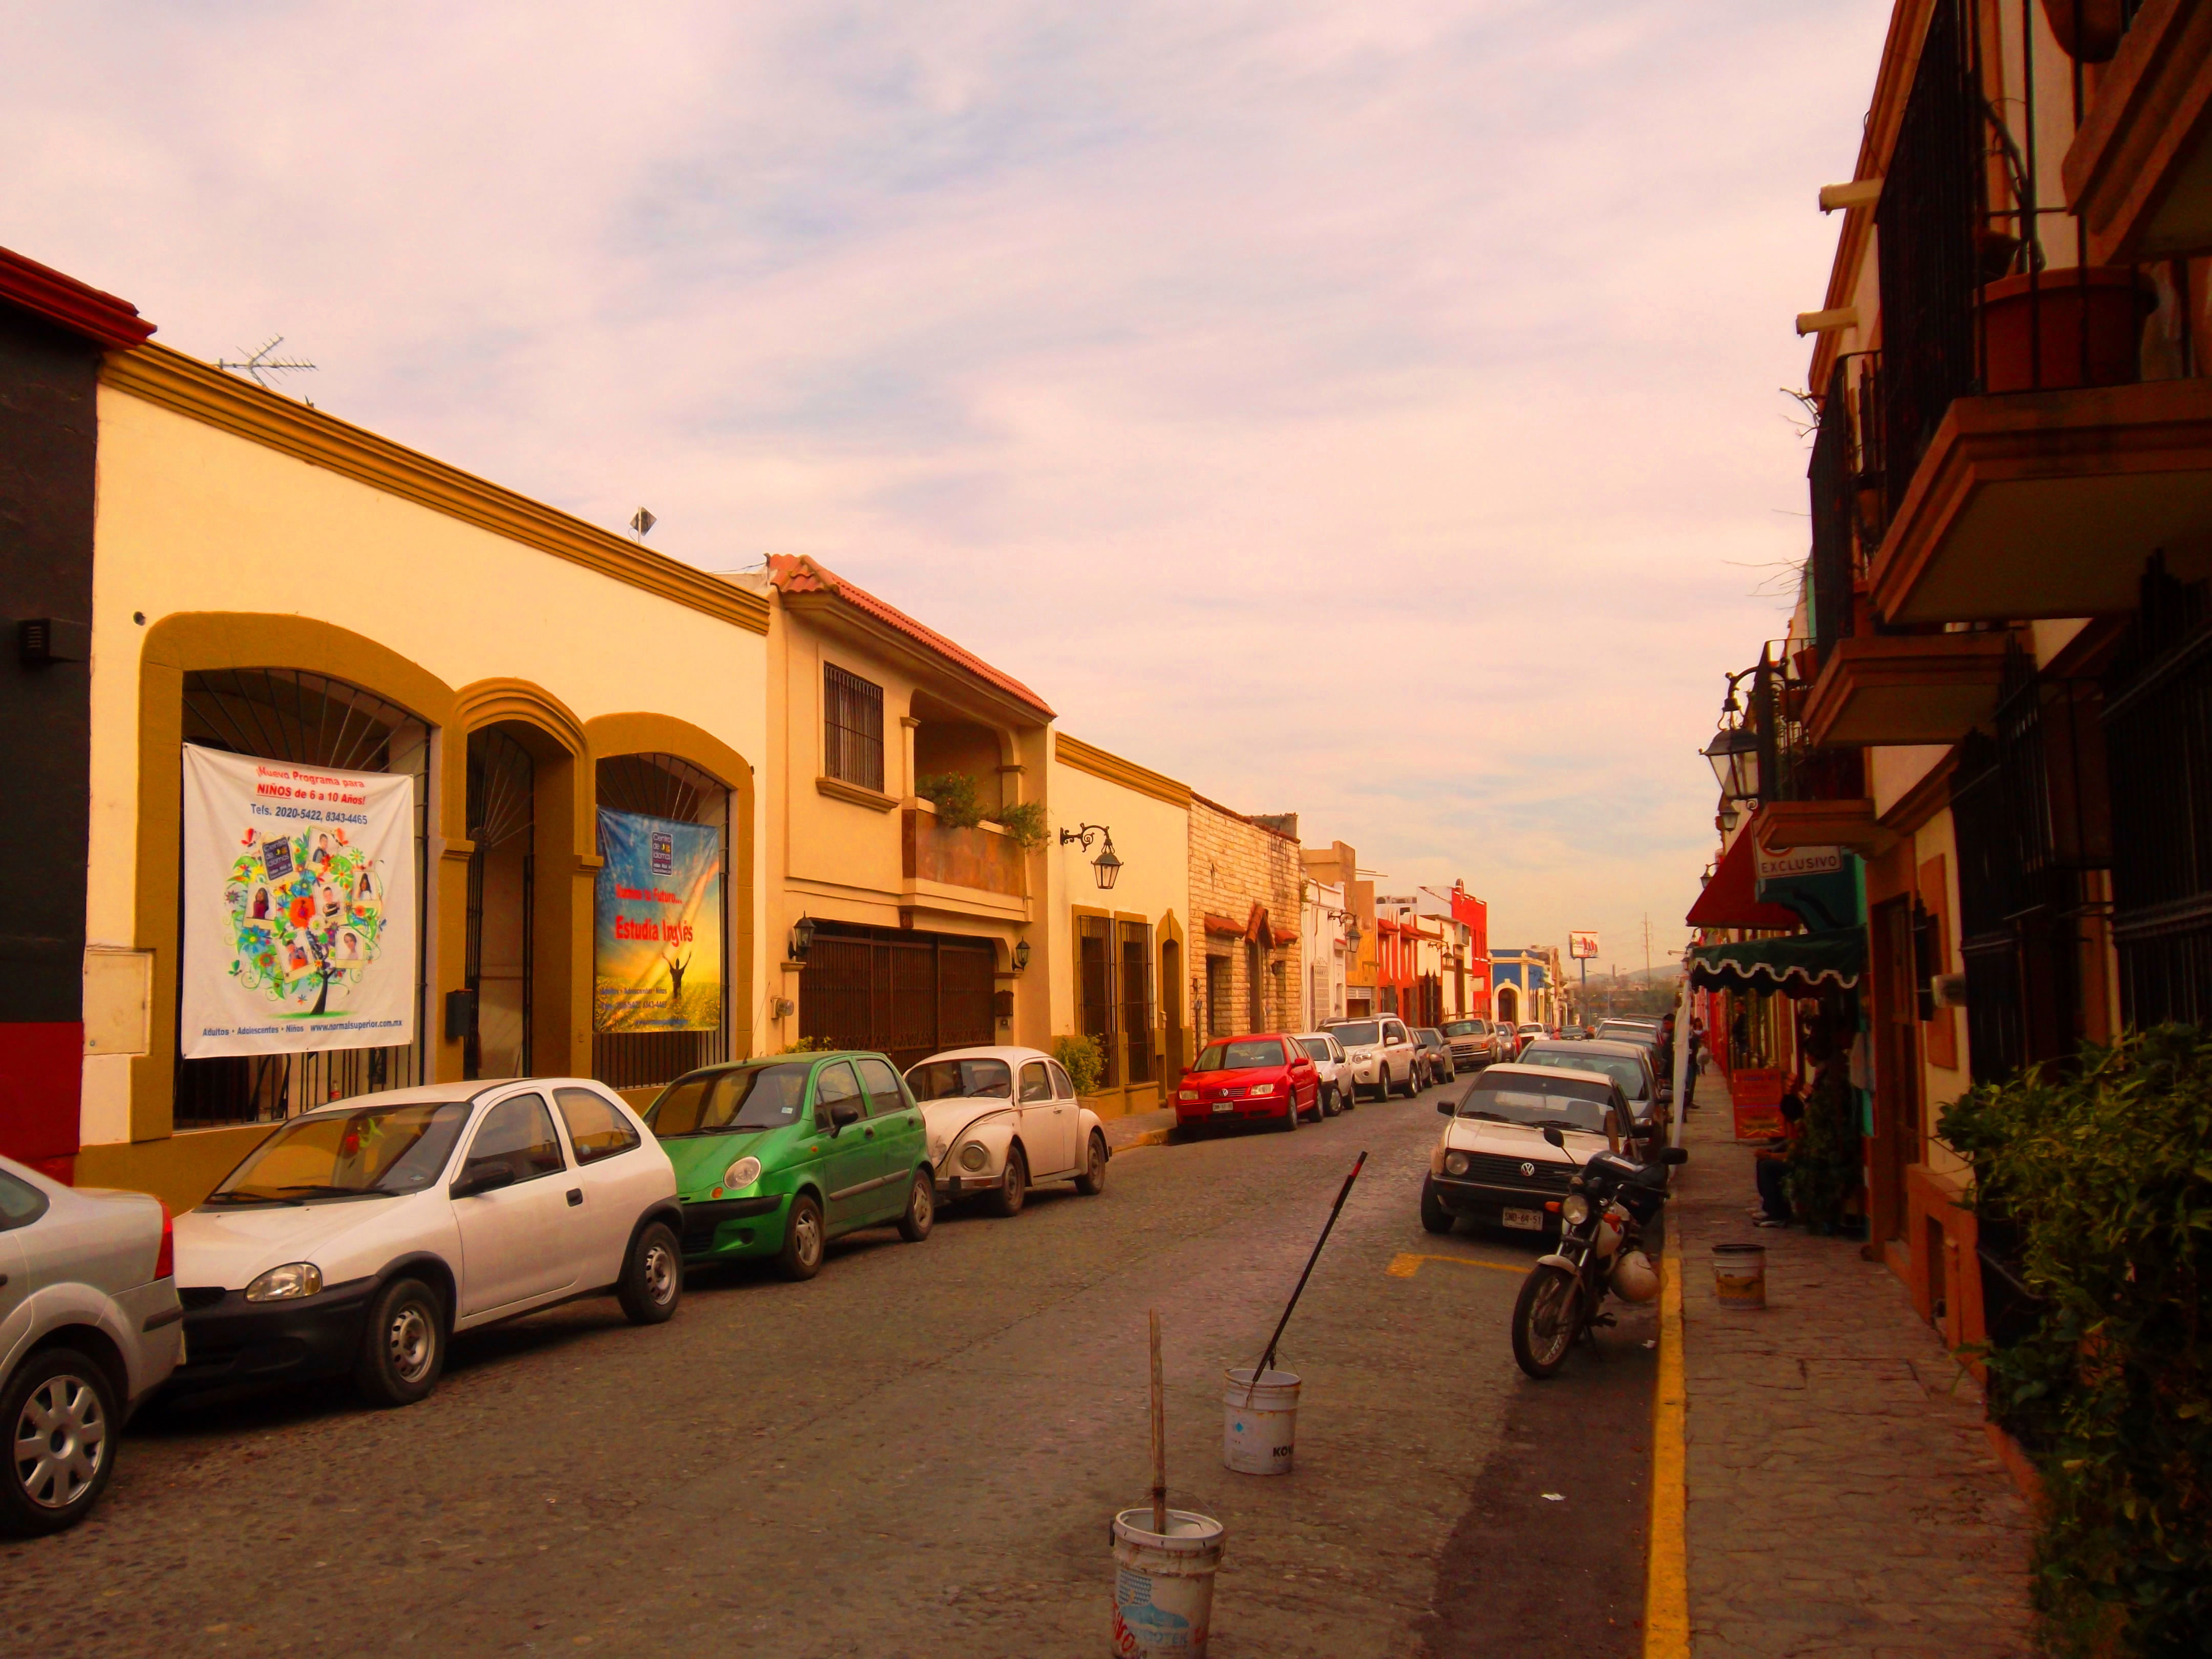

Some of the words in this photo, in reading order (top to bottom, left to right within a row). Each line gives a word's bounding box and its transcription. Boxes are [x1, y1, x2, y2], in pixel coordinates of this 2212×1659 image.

[257, 766, 290, 780] ¡Nuevo
[292, 771, 340, 785] Programa
[342, 779, 365, 788] para
[257, 783, 291, 797] NIÑOS
[294, 789, 307, 798] de
[309, 790, 315, 799] 6
[328, 792, 338, 802] 10
[341, 794, 366, 805] Años!
[251, 803, 272, 816] Tels.
[275, 806, 323, 822] 2020-5422,
[326, 812, 368, 824] 8343-4465
[653, 834, 671, 843] Centro
[1761, 855, 1837, 873] EXCLUSIVO
[615, 915, 659, 941] Estudia
[662, 919, 693, 947] Inglés
[202, 1028, 229, 1036] Adultos
[237, 1026, 279, 1035] Adolescentes
